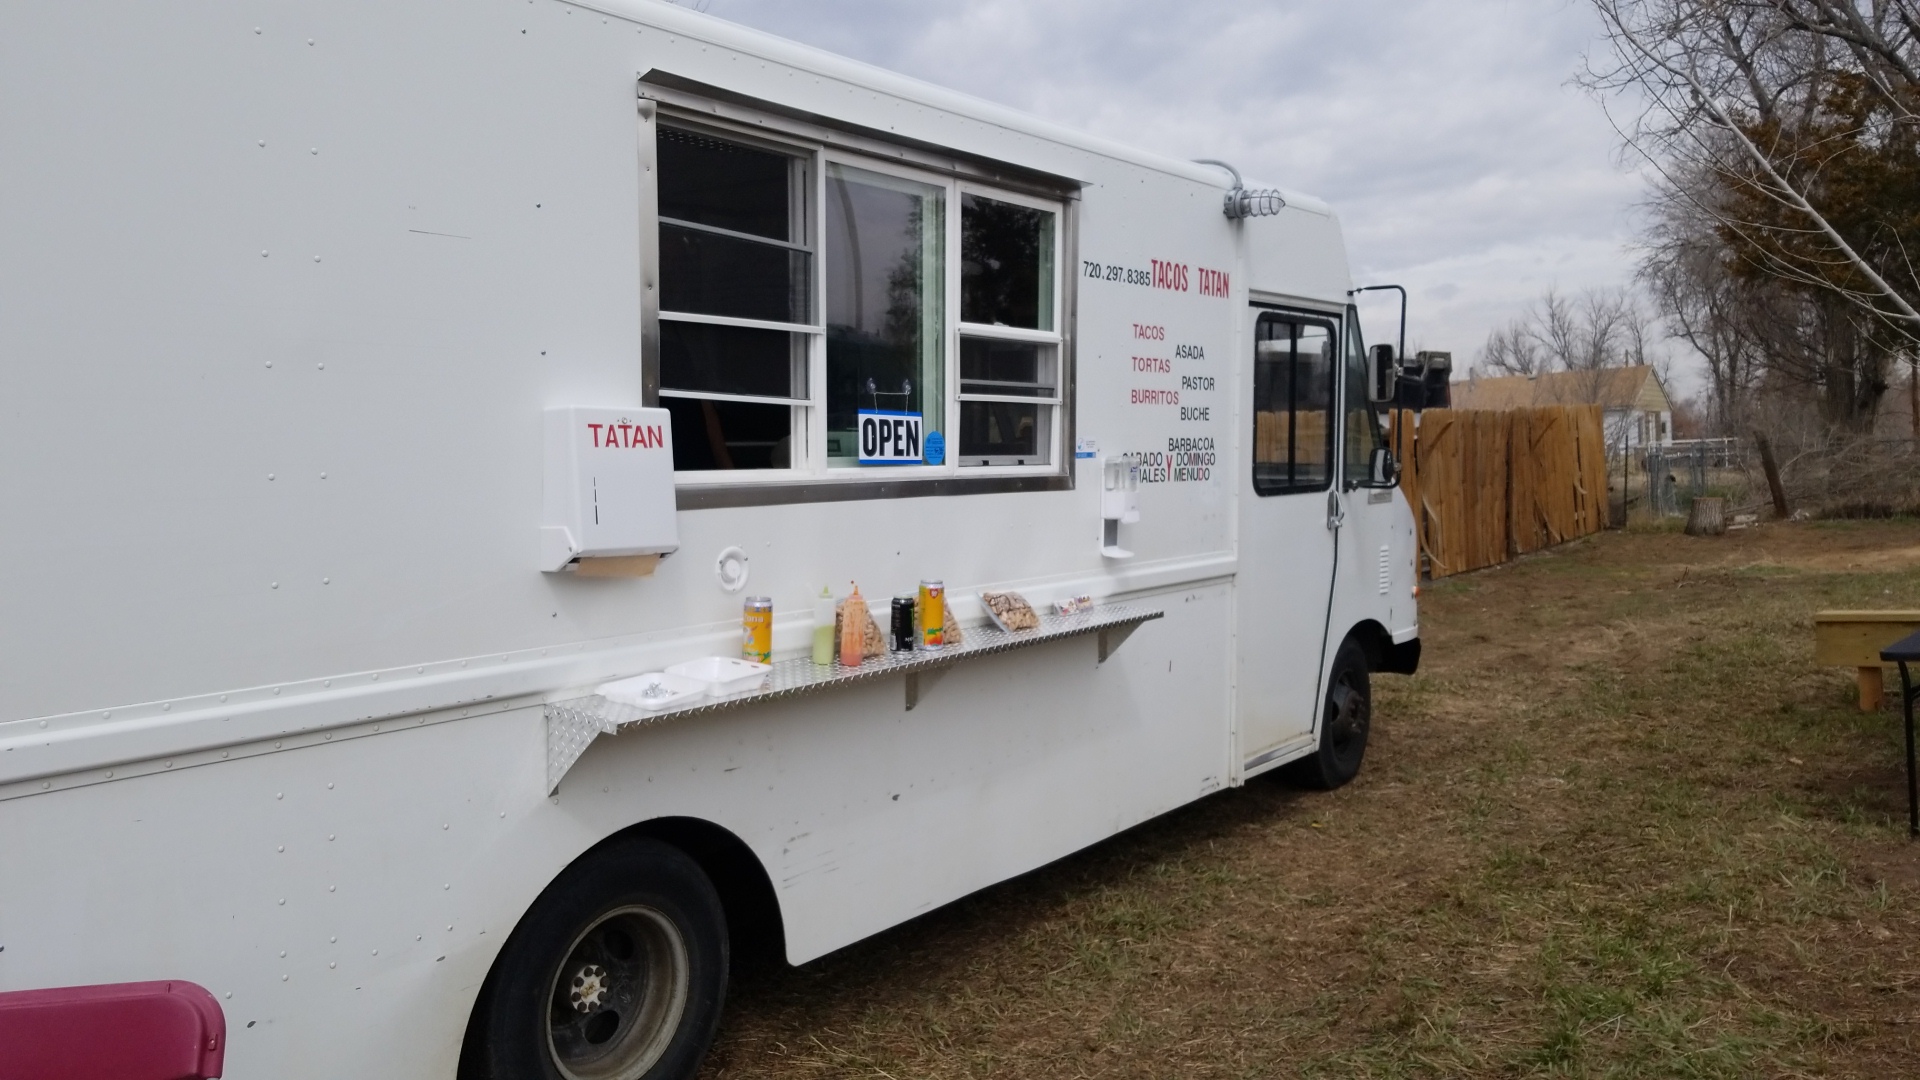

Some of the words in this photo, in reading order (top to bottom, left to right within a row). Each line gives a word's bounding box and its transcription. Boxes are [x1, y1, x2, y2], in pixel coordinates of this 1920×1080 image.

[1083, 260, 1151, 286] 720.297.8385
[1151, 259, 1188, 292] TACOS
[1198, 267, 1230, 299] TATAN
[1132, 323, 1165, 341] TACOS
[1175, 344, 1205, 360] ASADA
[1131, 356, 1171, 373] TORTAS
[1181, 375, 1215, 391] PASTOR
[1131, 389, 1179, 405] BURRITOS
[1180, 407, 1210, 421] BUCHE
[587, 423, 664, 449] TATAN
[862, 417, 919, 457] OPEN
[1168, 437, 1215, 452] BARBACOA
[1122, 451, 1163, 467] BADO
[1166, 454, 1173, 482] Y
[1176, 452, 1216, 467] DOMINGO
[1173, 467, 1210, 482] MENUDO
